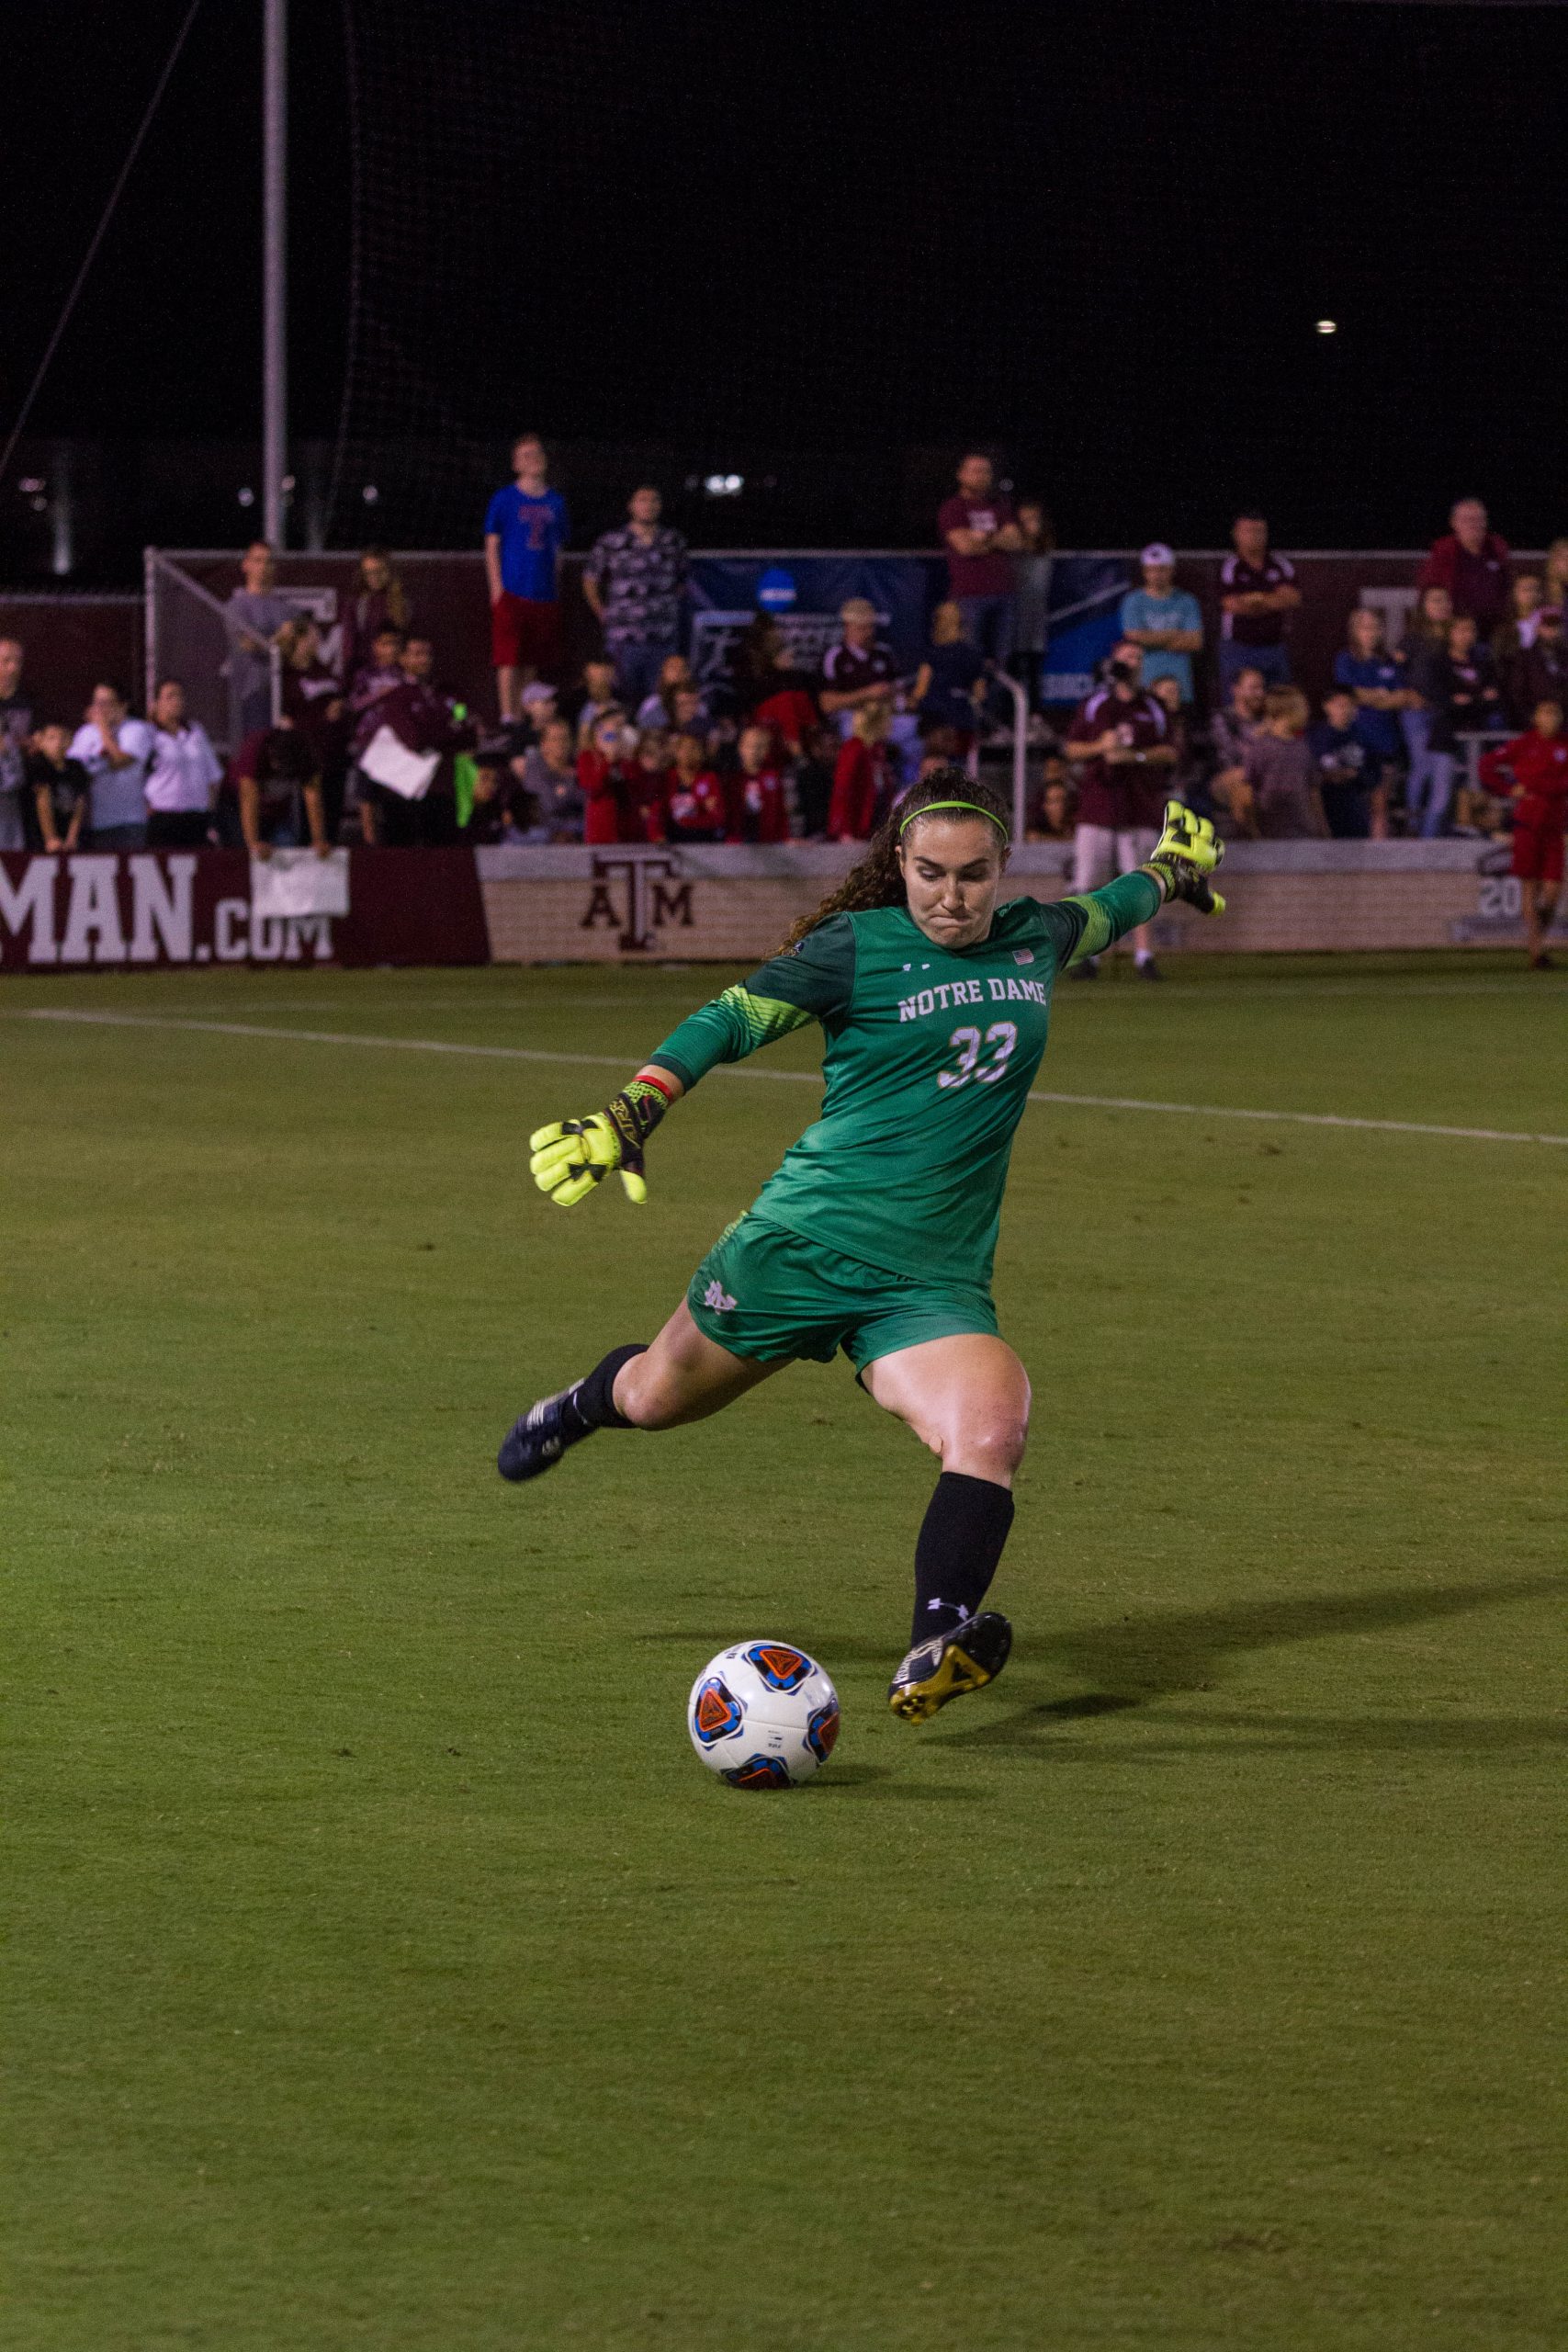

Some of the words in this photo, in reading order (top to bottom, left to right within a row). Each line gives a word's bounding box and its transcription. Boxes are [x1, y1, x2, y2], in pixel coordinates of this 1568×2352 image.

[897, 979, 984, 1023] NOTRE
[987, 978, 1047, 1006] DAME
[937, 1022, 1017, 1088] 33
